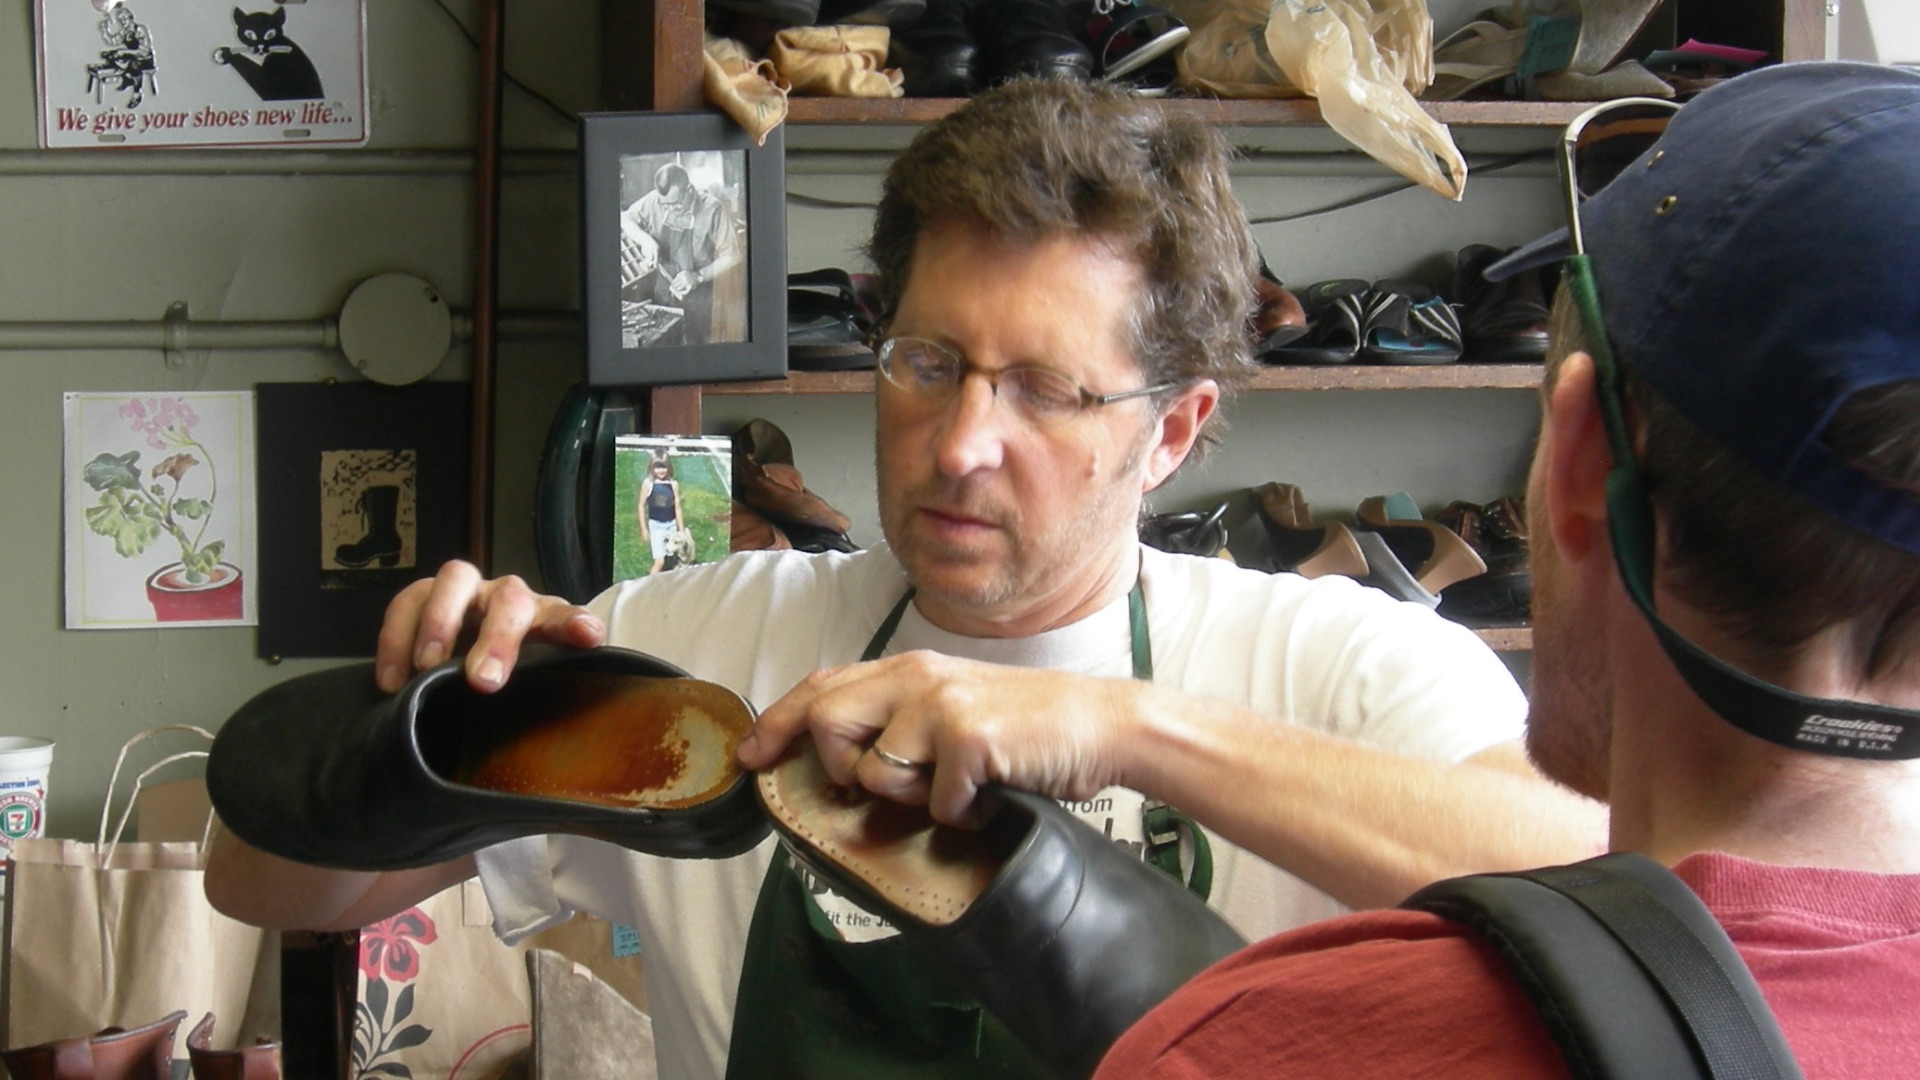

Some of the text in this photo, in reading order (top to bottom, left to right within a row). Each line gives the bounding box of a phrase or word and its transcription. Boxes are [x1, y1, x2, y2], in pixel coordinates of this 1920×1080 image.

[57, 102, 353, 134] We give your shoes new life...
[847, 912, 871, 927] the
